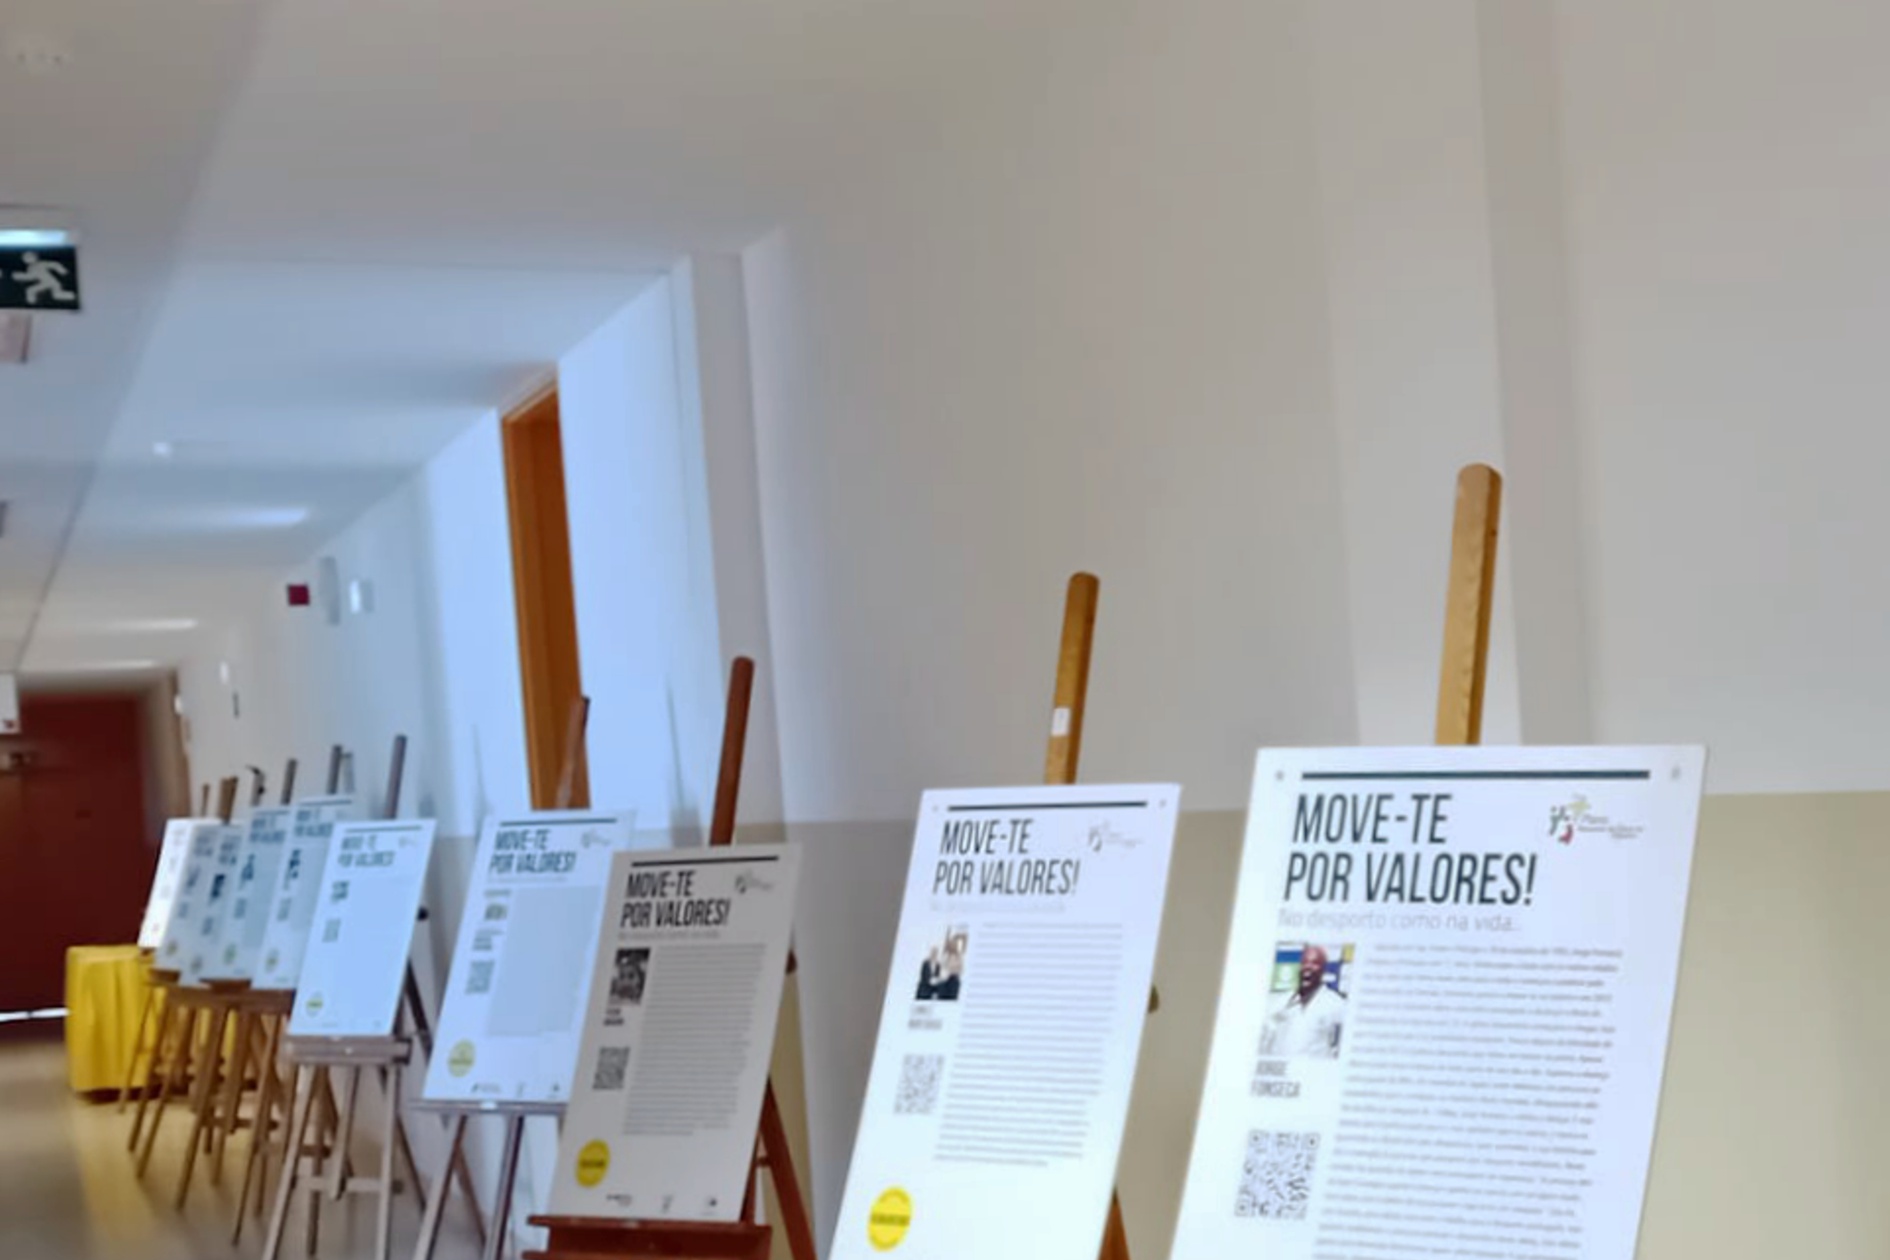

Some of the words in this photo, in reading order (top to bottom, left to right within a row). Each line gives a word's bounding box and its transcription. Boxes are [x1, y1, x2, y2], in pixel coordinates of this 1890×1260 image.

[939, 818, 1033, 855] MOVE-TE
[1292, 793, 1453, 845] MOVE-TE
[626, 870, 696, 898] MOVE-TE
[933, 860, 975, 895] POR
[980, 859, 1080, 896] VALORES!
[1284, 853, 1353, 902] POR
[1364, 852, 1538, 906] VALORES!
[620, 902, 652, 928] POR
[656, 899, 731, 928] VALORES!
[1307, 909, 1386, 933] desporto
